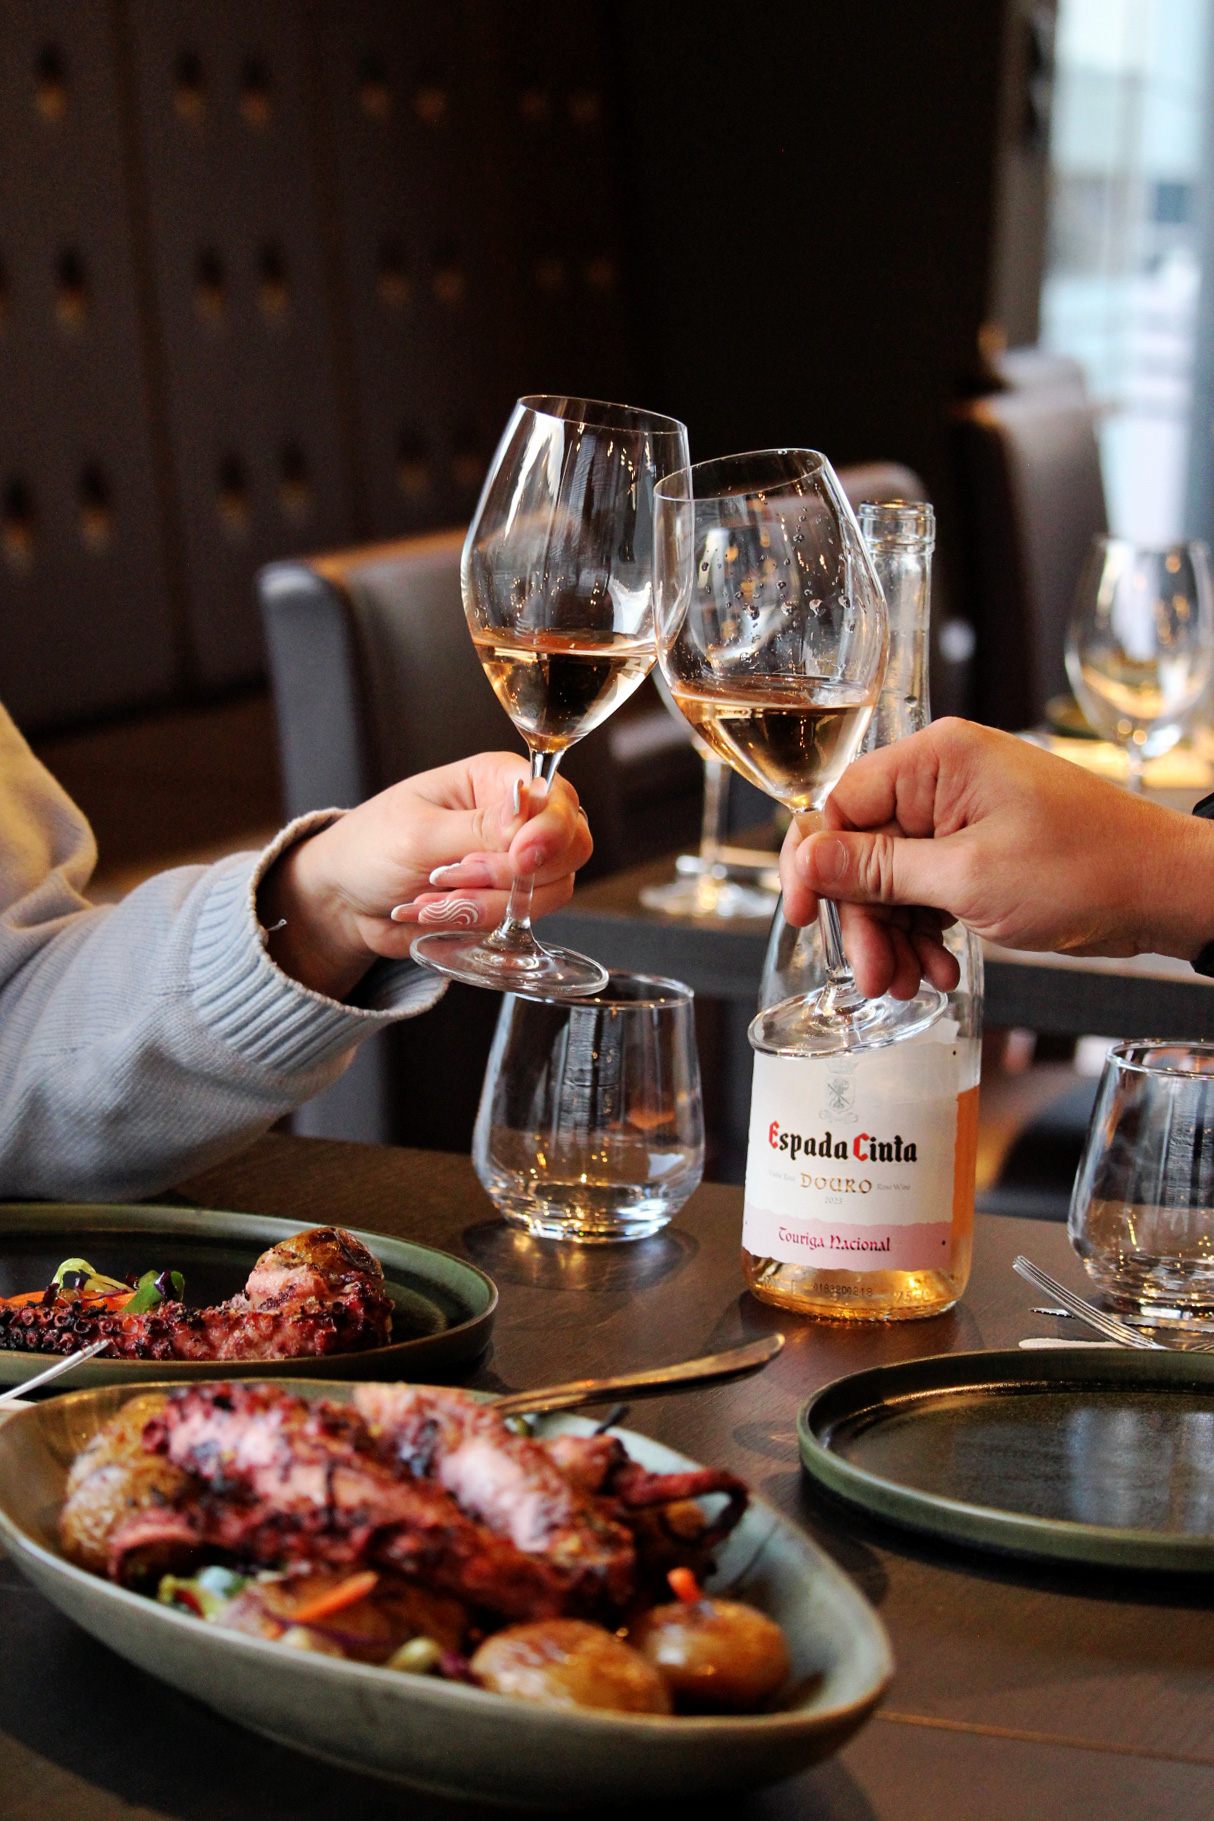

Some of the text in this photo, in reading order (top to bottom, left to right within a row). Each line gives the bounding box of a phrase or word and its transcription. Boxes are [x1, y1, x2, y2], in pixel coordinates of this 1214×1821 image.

[768, 1120, 918, 1162] Espada Cinta
[800, 1172, 873, 1194] DOURO
[778, 1226, 891, 1252] Touriga Nacional
